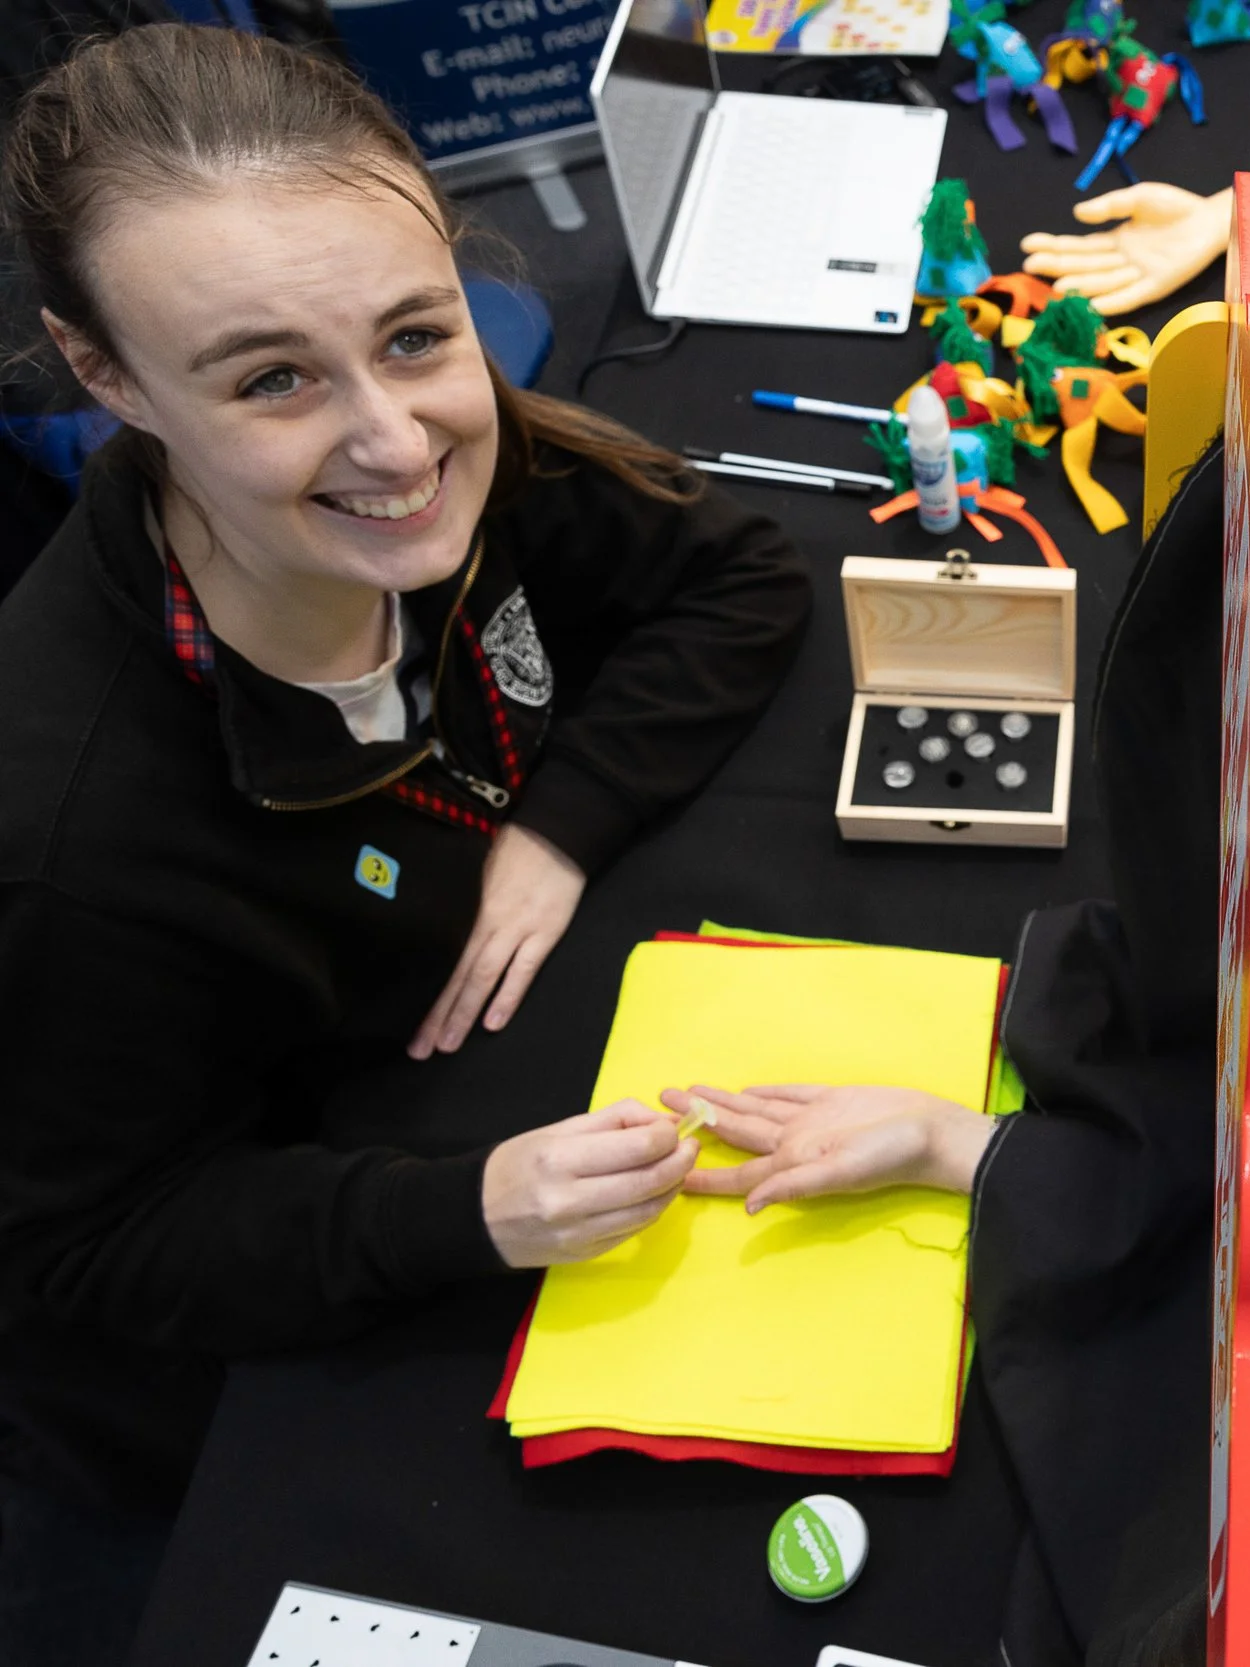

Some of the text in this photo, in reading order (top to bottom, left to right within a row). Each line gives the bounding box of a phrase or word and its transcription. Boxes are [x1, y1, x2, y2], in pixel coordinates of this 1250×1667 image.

[421, 35, 536, 78] E-mail:
[472, 60, 580, 102] Phone:
[421, 112, 503, 147] Web:
